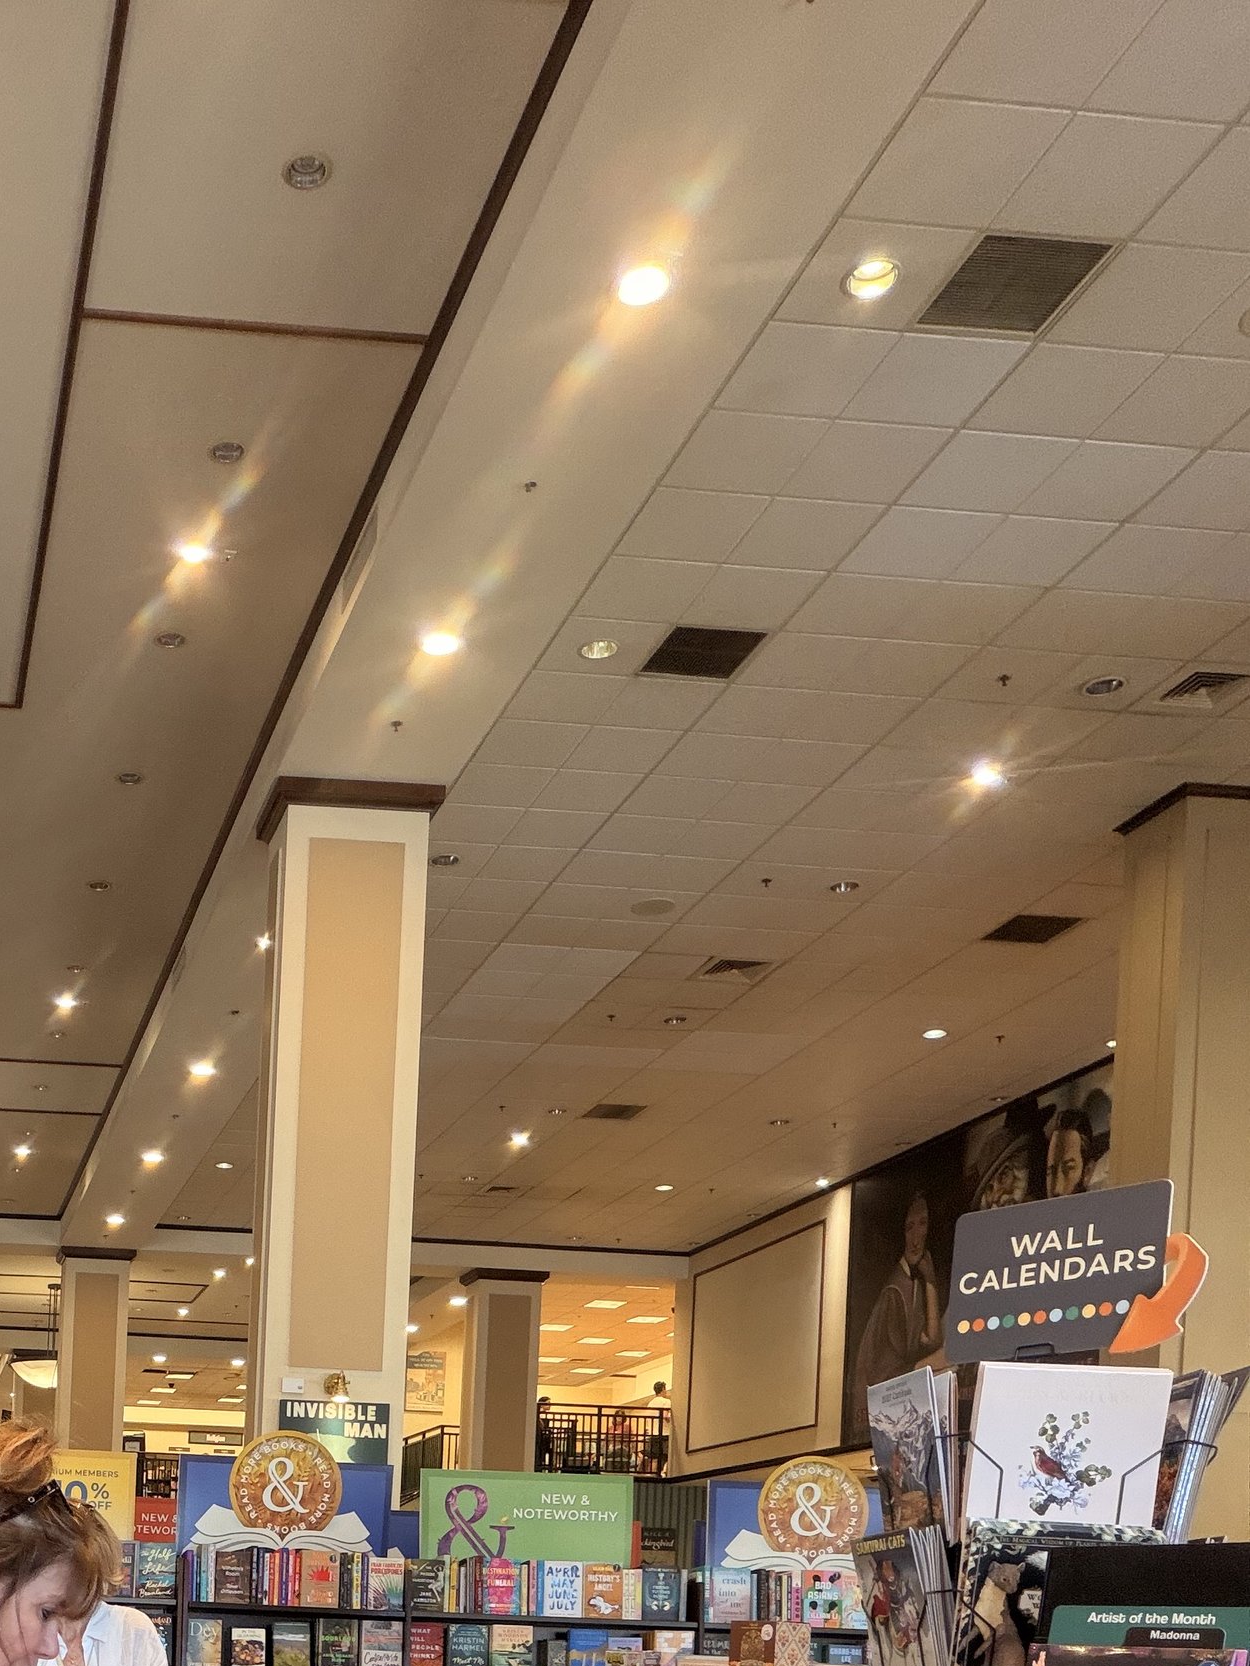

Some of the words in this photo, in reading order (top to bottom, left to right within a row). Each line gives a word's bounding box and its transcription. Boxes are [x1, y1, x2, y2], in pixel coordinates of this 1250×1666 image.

[1010, 1223, 1104, 1258] WALL
[958, 1245, 1157, 1295] CALENDARS
[286, 1401, 377, 1421] INVISIBLE
[344, 1422, 387, 1439] MAN
[262, 1441, 306, 1455] BOOKS
[75, 1469, 119, 1478] MEMBERS
[240, 1452, 261, 1483] MORE
[314, 1457, 331, 1489] READ
[791, 1467, 831, 1480] BOOKS
[540, 1493, 576, 1505] NEW
[581, 1495, 591, 1505] &
[768, 1478, 790, 1508] MORE
[841, 1481, 858, 1513] READ
[239, 1487, 258, 1520] READ
[309, 1492, 332, 1525] MORE
[141, 1513, 169, 1523] NEW
[513, 1508, 619, 1523] NOTEWORTHY
[768, 1513, 787, 1544] READ
[836, 1517, 858, 1548] MORE
[888, 1534, 906, 1548] CATS
[551, 1578, 575, 1589] MAY
[587, 1574, 621, 1583] HISTORY'S
[722, 1576, 747, 1586] crash
[814, 1581, 831, 1590] BAD
[548, 1589, 578, 1600] JUNE
[807, 1591, 839, 1601] ASIANS
[549, 1600, 577, 1611] JULY
[1087, 1612, 1126, 1624] Artist
[1129, 1612, 1143, 1624] of
[1144, 1612, 1169, 1625] the
[1171, 1613, 1216, 1626] Month
[453, 1636, 485, 1644] KRISTIN
[1149, 1629, 1200, 1641] Madonna
[451, 1644, 485, 1652] HARMEL
